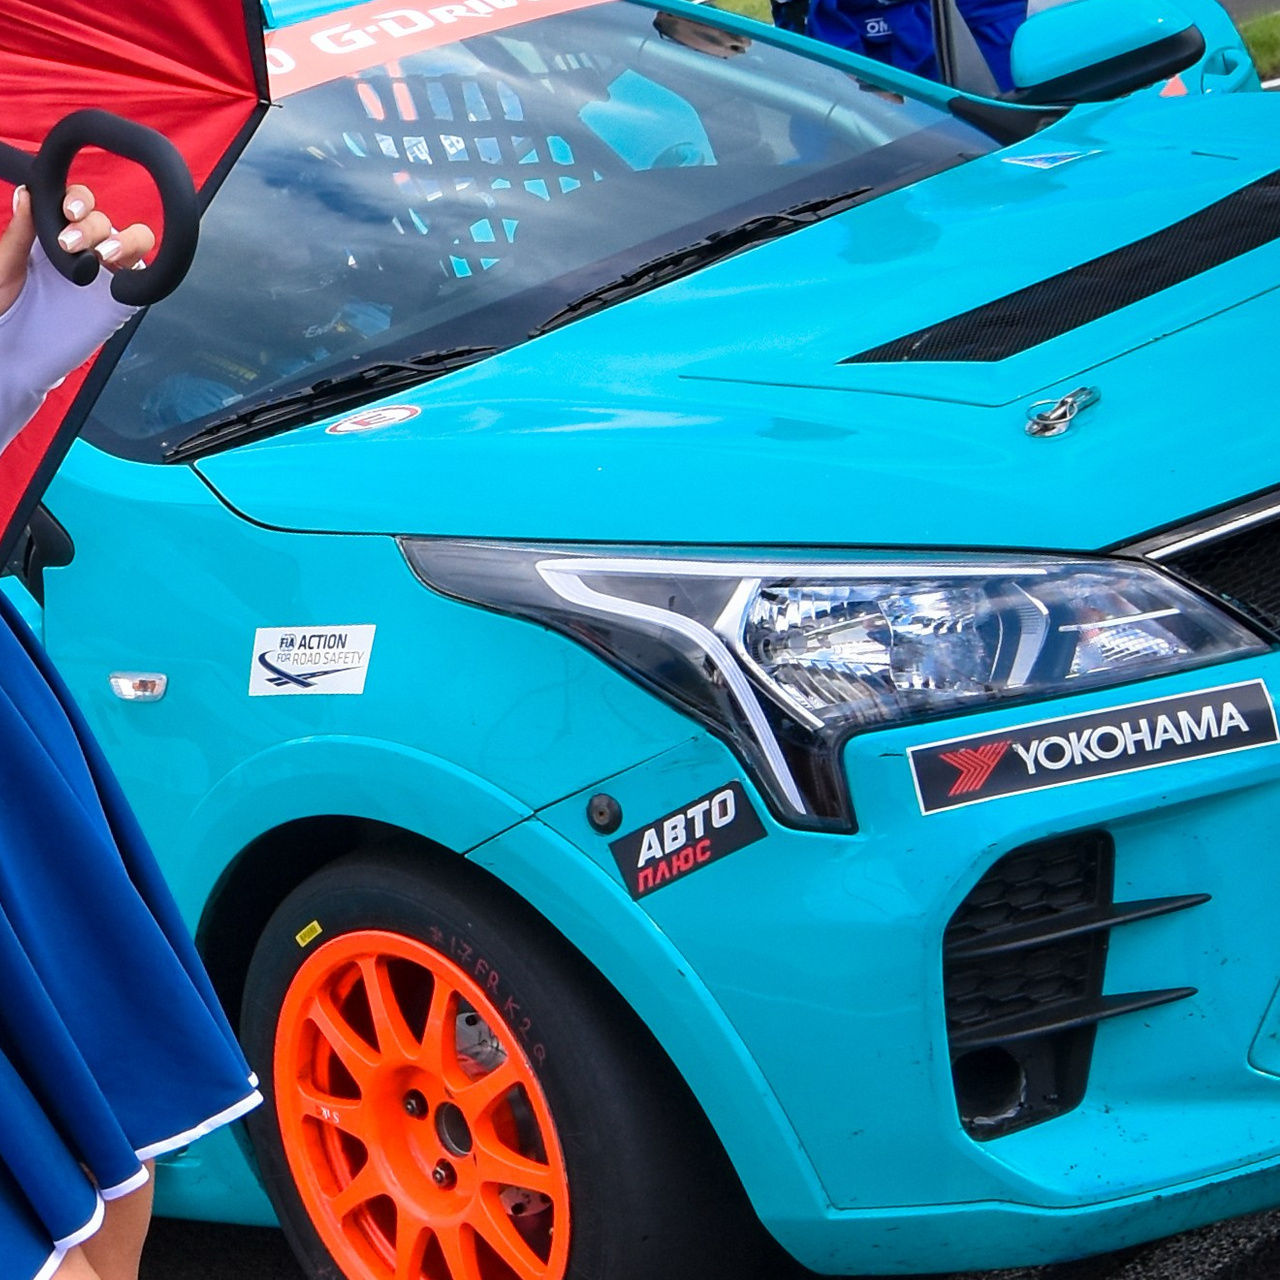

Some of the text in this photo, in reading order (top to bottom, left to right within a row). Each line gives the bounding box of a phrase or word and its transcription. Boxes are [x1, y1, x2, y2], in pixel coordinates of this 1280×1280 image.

[276, 651, 365, 666] FOR ROAD SAFETY
[298, 633, 349, 651] ACTION
[1014, 701, 1251, 775] YOKOHAMA
[637, 789, 736, 869] АВТО
[637, 838, 712, 893] ПЛЮС
